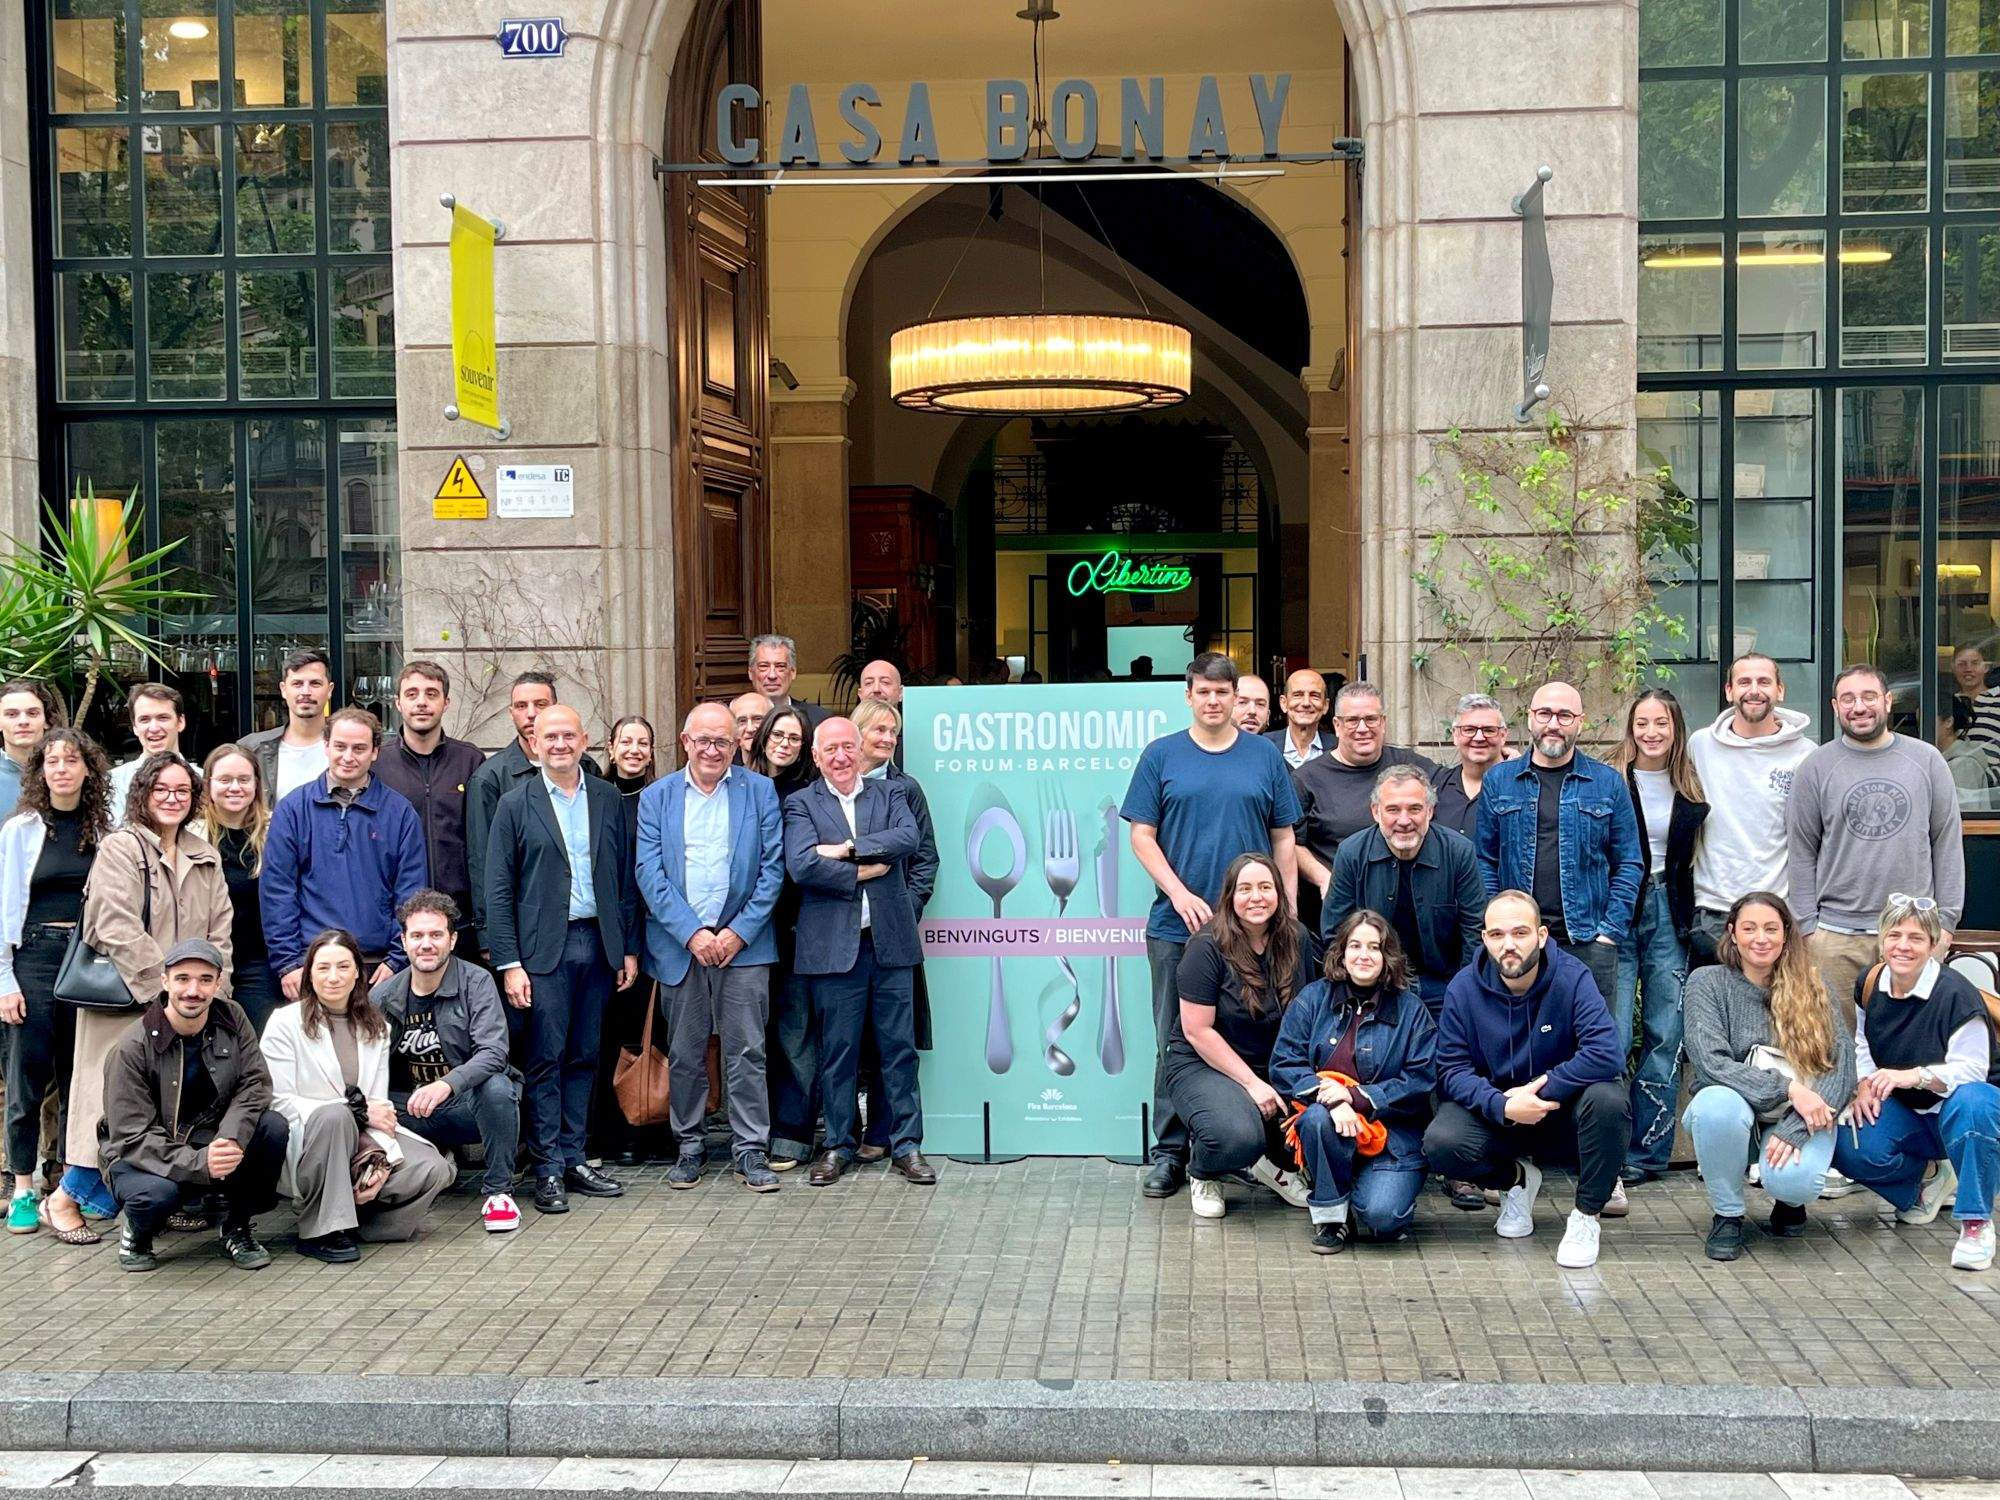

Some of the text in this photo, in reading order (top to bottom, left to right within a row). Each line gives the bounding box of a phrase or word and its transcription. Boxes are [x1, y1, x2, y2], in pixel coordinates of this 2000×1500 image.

[505, 22, 558, 52] 700
[716, 73, 1292, 165] CASA BONAY
[554, 469, 569, 482] TC
[1068, 550, 1192, 596] Libertine
[933, 710, 1167, 751] GASTRONOMIC
[1026, 756, 1132, 771] BARCELO
[1850, 815, 1902, 836] COMPANY
[925, 928, 1040, 943] BENVINGUTS
